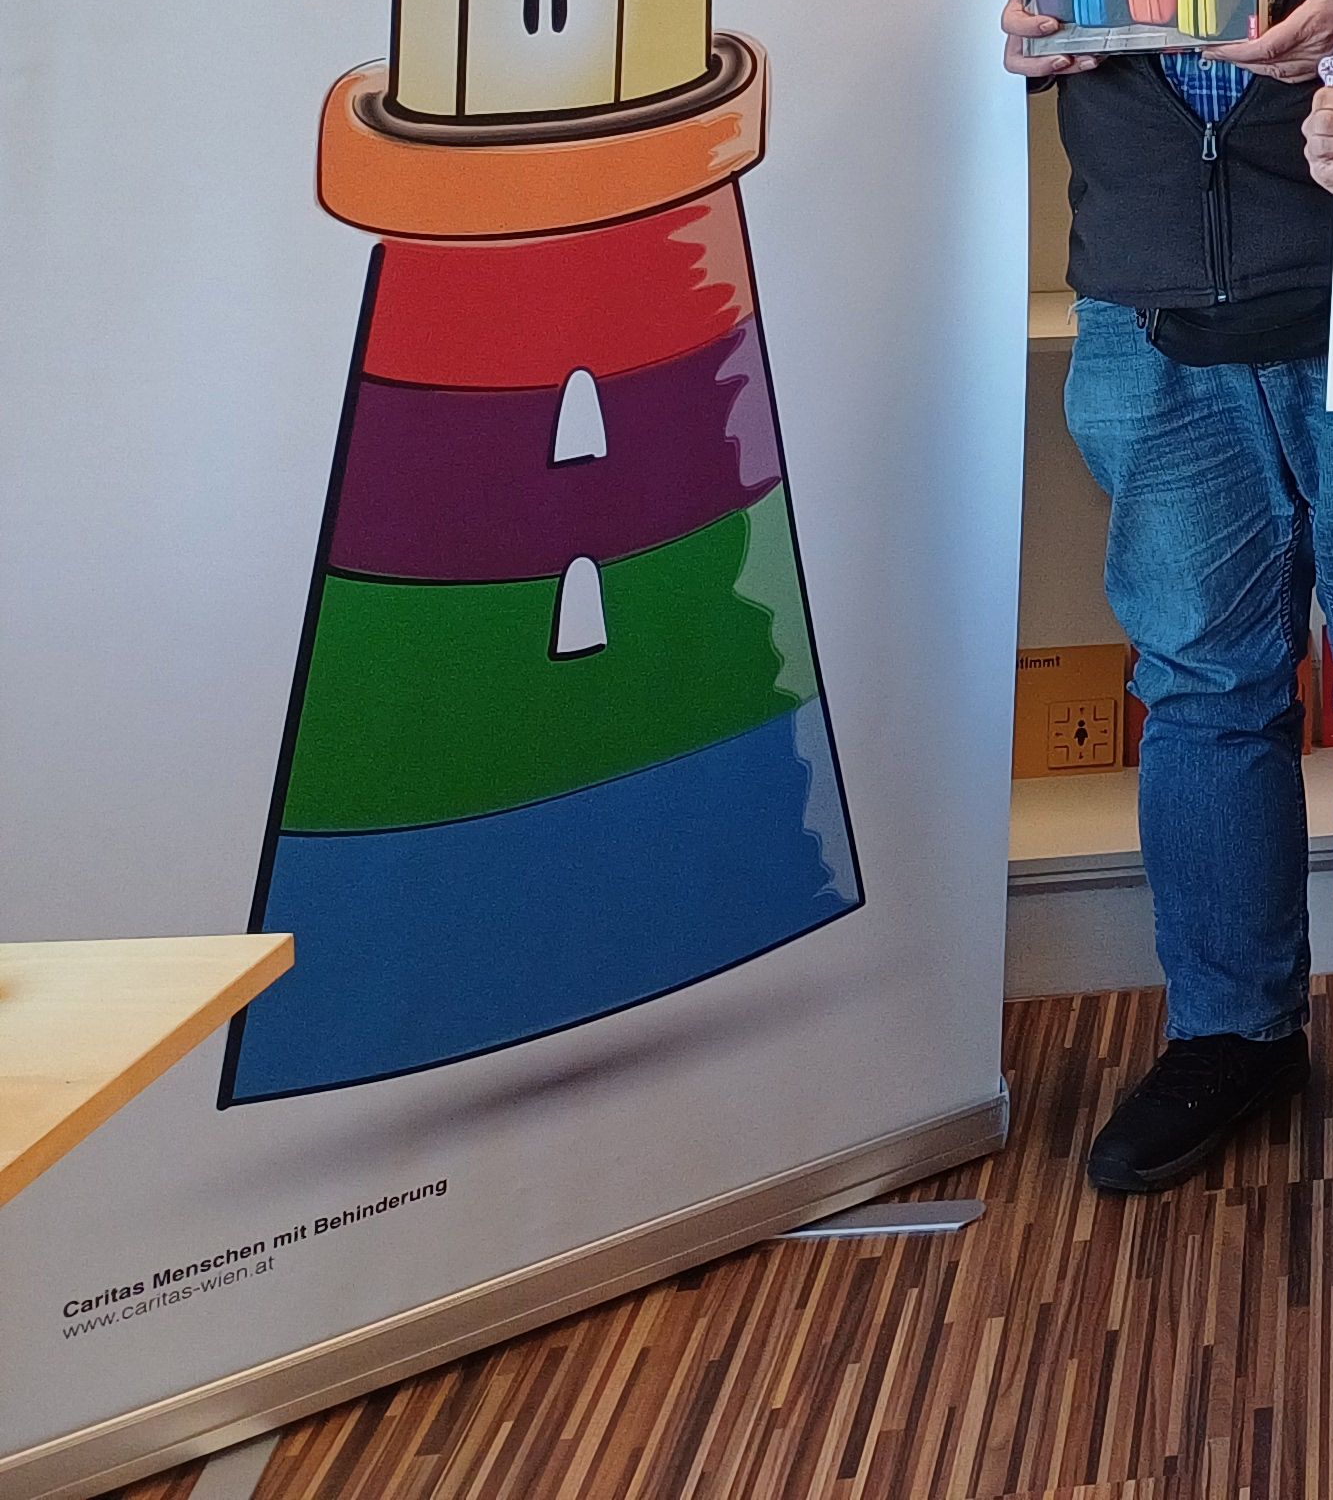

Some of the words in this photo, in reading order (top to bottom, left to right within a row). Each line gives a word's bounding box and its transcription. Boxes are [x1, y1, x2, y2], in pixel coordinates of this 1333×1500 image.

[61, 1255, 276, 1340] www.caritas-wien.at
[62, 1281, 146, 1319] Caritas
[152, 1241, 266, 1290] Menschen
[272, 1223, 308, 1251] mit
[313, 1177, 449, 1237] Behinderung
